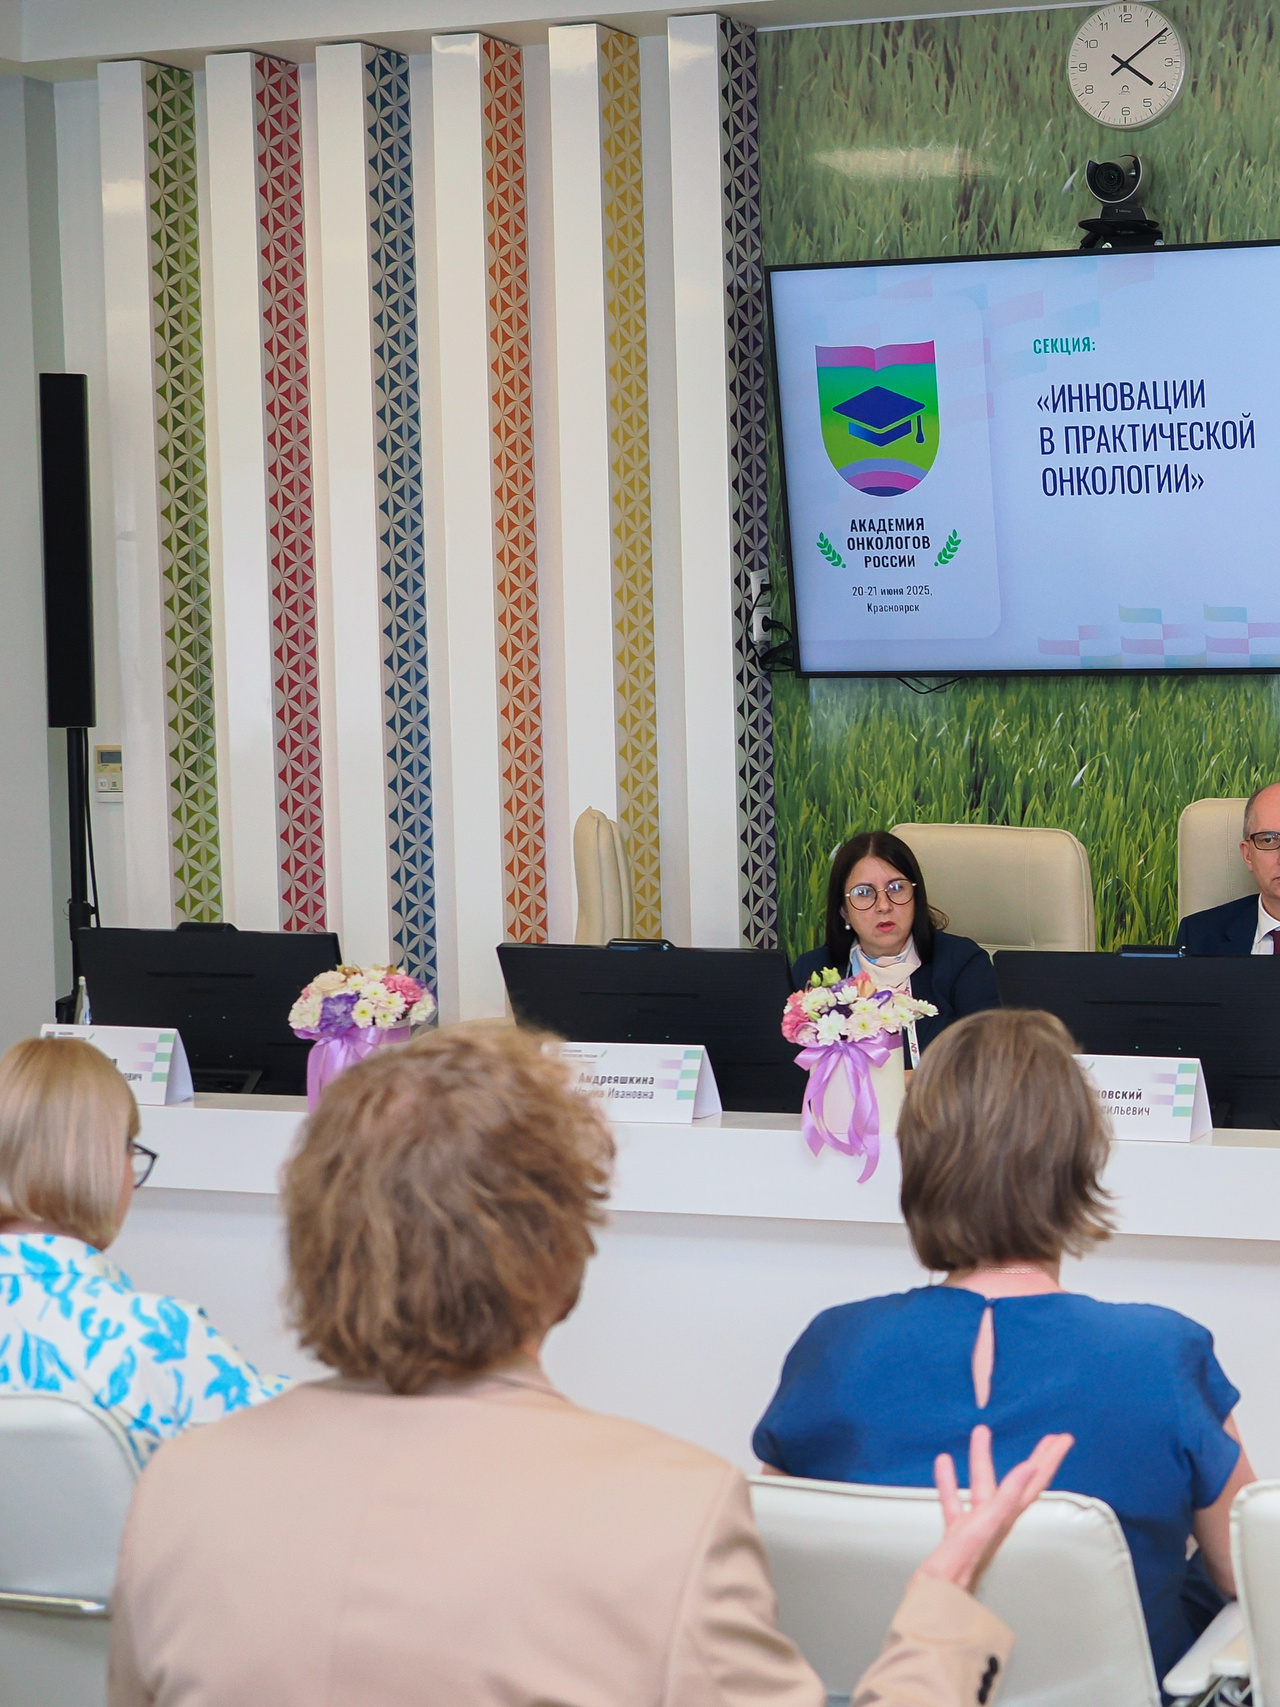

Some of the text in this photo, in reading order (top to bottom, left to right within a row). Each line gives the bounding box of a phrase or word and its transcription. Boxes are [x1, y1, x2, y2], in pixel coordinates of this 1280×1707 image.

[1119, 13, 1133, 23] 12
[1144, 18, 1150, 28] 1
[1100, 22, 1109, 31] 11
[1084, 39, 1098, 48] 10
[1157, 35, 1168, 45] 2
[1078, 62, 1088, 72] 9
[1164, 58, 1174, 67] 3
[1084, 84, 1094, 94] 8
[1158, 80, 1167, 89] 4
[1101, 101, 1110, 110] 7
[1142, 98, 1152, 108] 5
[1121, 107, 1131, 116] 6
[1033, 336, 1096, 355] СЕКЦИЯ:
[1036, 378, 1206, 415] «ИННОВАЦИИ
[1039, 412, 1256, 455] В ПРАКТИЧЕСКОЙ
[1041, 463, 1205, 497] ОНКОЛОГИИ»
[850, 517, 925, 534] АКАДЕМИЯ
[847, 535, 931, 551] ОНКОЛОГОВ
[864, 554, 916, 569] РОССИИ
[852, 585, 933, 597] 20-21 июня 2025,
[867, 602, 920, 615] Красноярск
[1098, 1088, 1142, 1100] овский
[1101, 1105, 1150, 1116] сильевич
